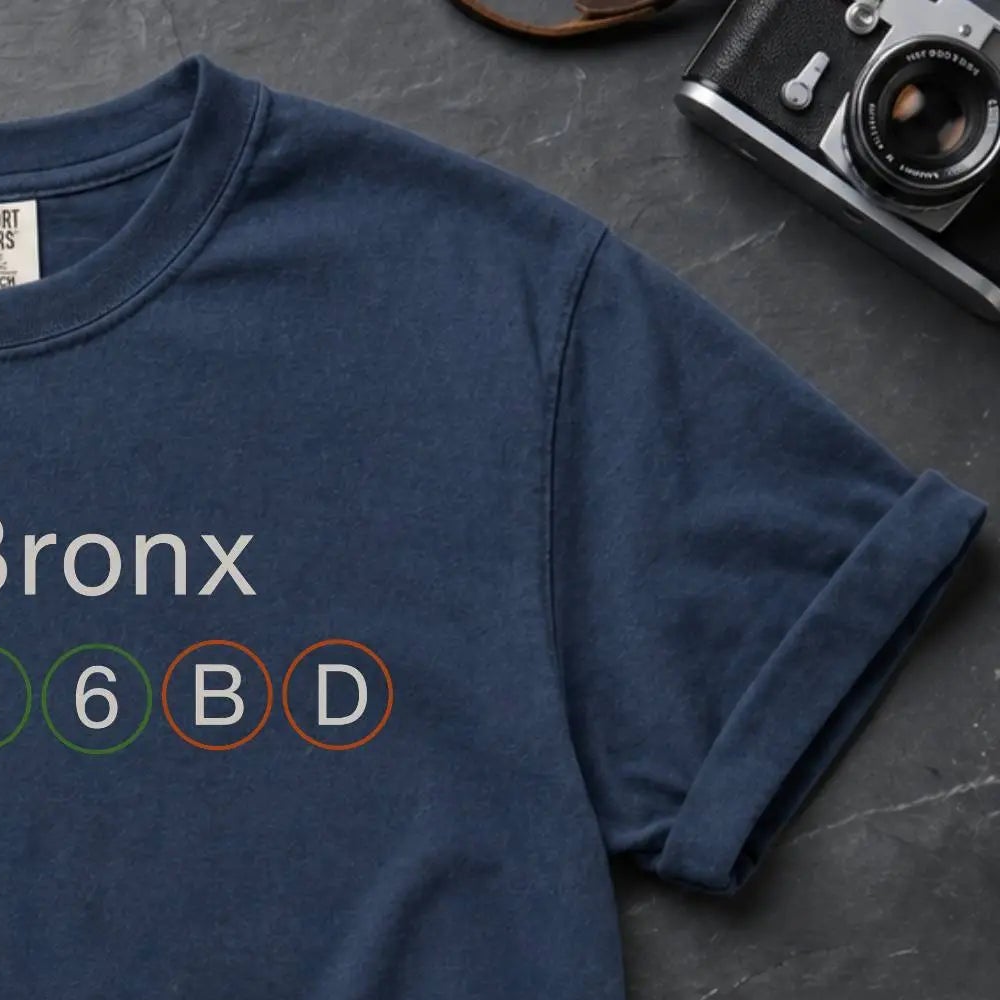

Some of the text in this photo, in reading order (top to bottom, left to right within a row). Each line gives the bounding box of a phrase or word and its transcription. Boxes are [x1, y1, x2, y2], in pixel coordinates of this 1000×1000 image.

[75, 666, 119, 729] 6
[195, 664, 245, 726] B
[318, 664, 368, 726] D
